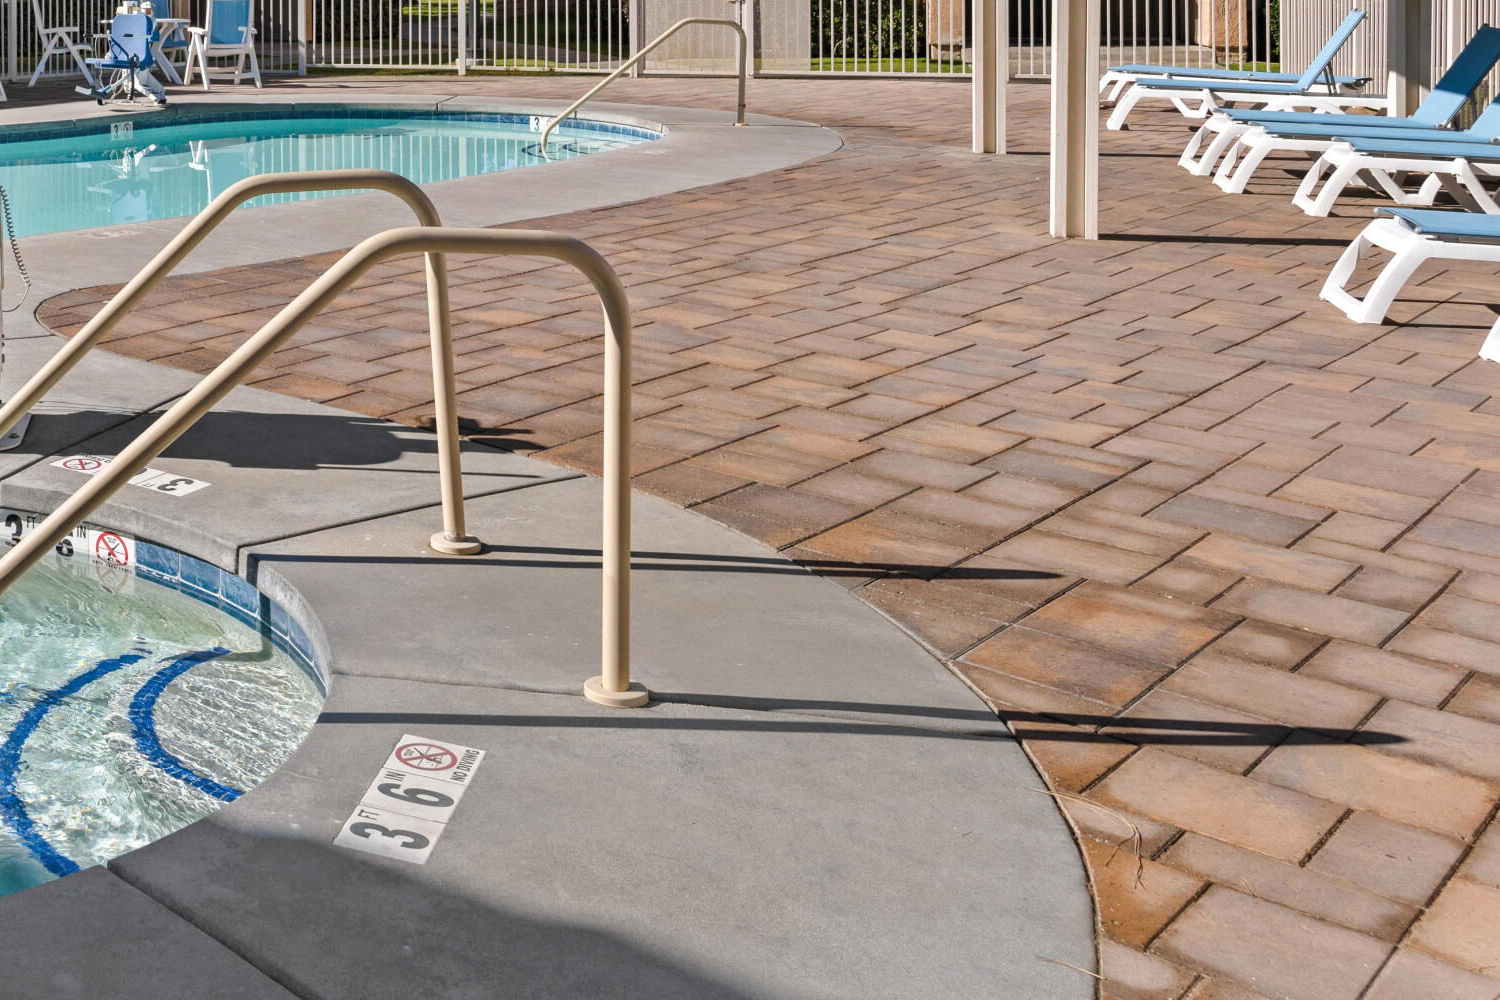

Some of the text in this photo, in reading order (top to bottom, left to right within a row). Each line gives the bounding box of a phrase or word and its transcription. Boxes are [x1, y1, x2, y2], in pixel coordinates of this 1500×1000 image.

[533, 116, 540, 132] 3
[157, 478, 194, 491] 3
[4, 513, 23, 548] 3
[26, 516, 37, 529] FT
[76, 525, 87, 539] IN
[449, 749, 481, 783] NO DIVING
[349, 770, 455, 850] 3 FT 6 IN
